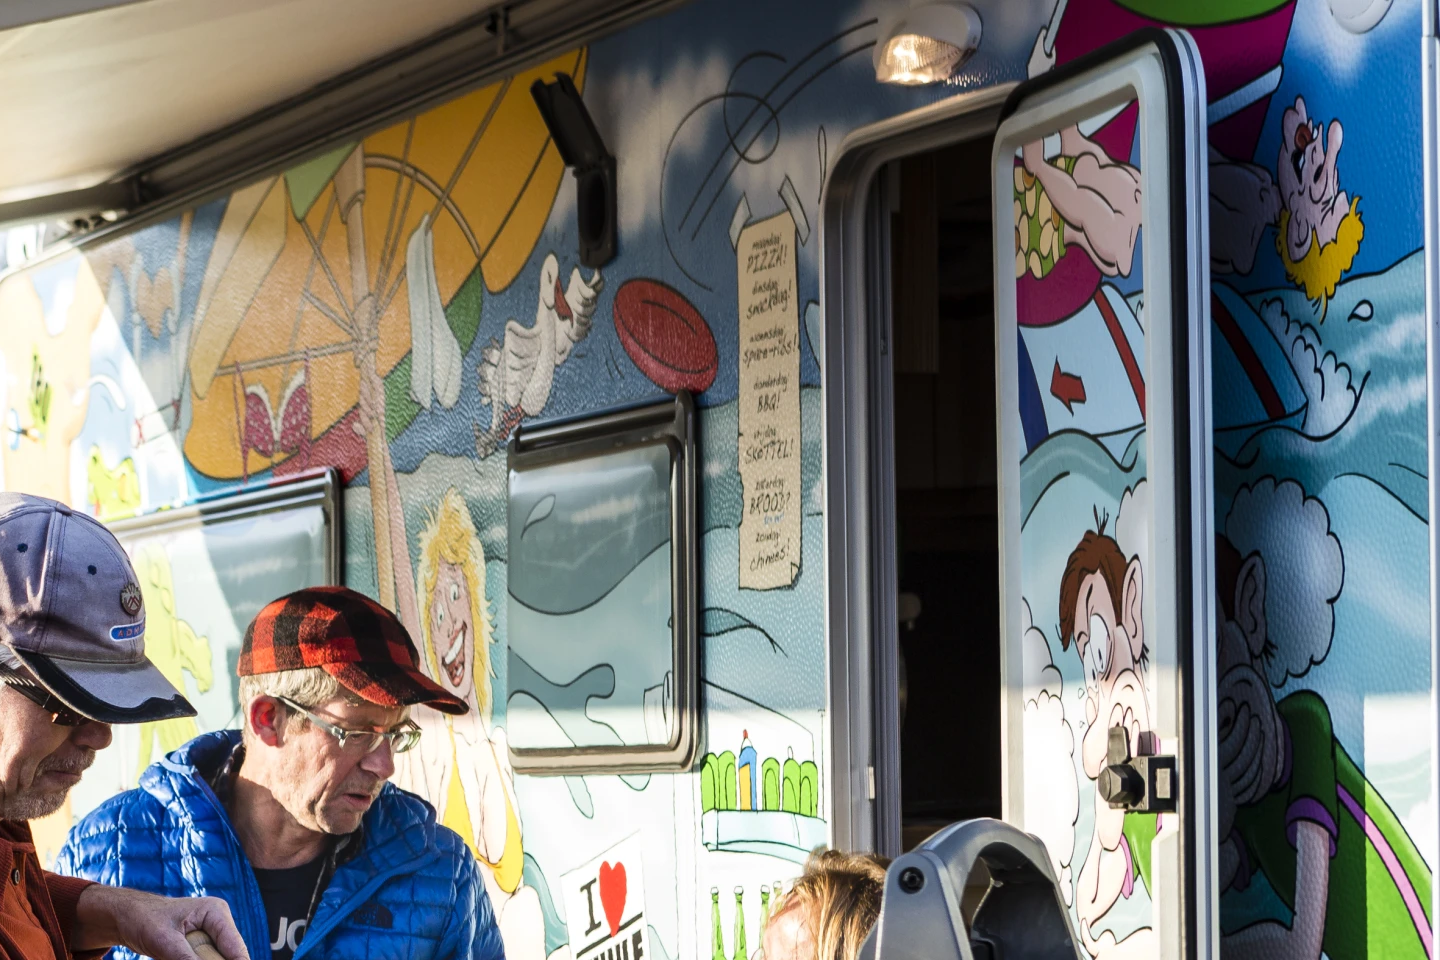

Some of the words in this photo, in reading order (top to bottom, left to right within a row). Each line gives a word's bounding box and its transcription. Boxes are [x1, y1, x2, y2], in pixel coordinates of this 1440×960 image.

[747, 244, 788, 274] PIZZA!
[757, 390, 781, 413] BBQ!
[580, 877, 602, 937] I
